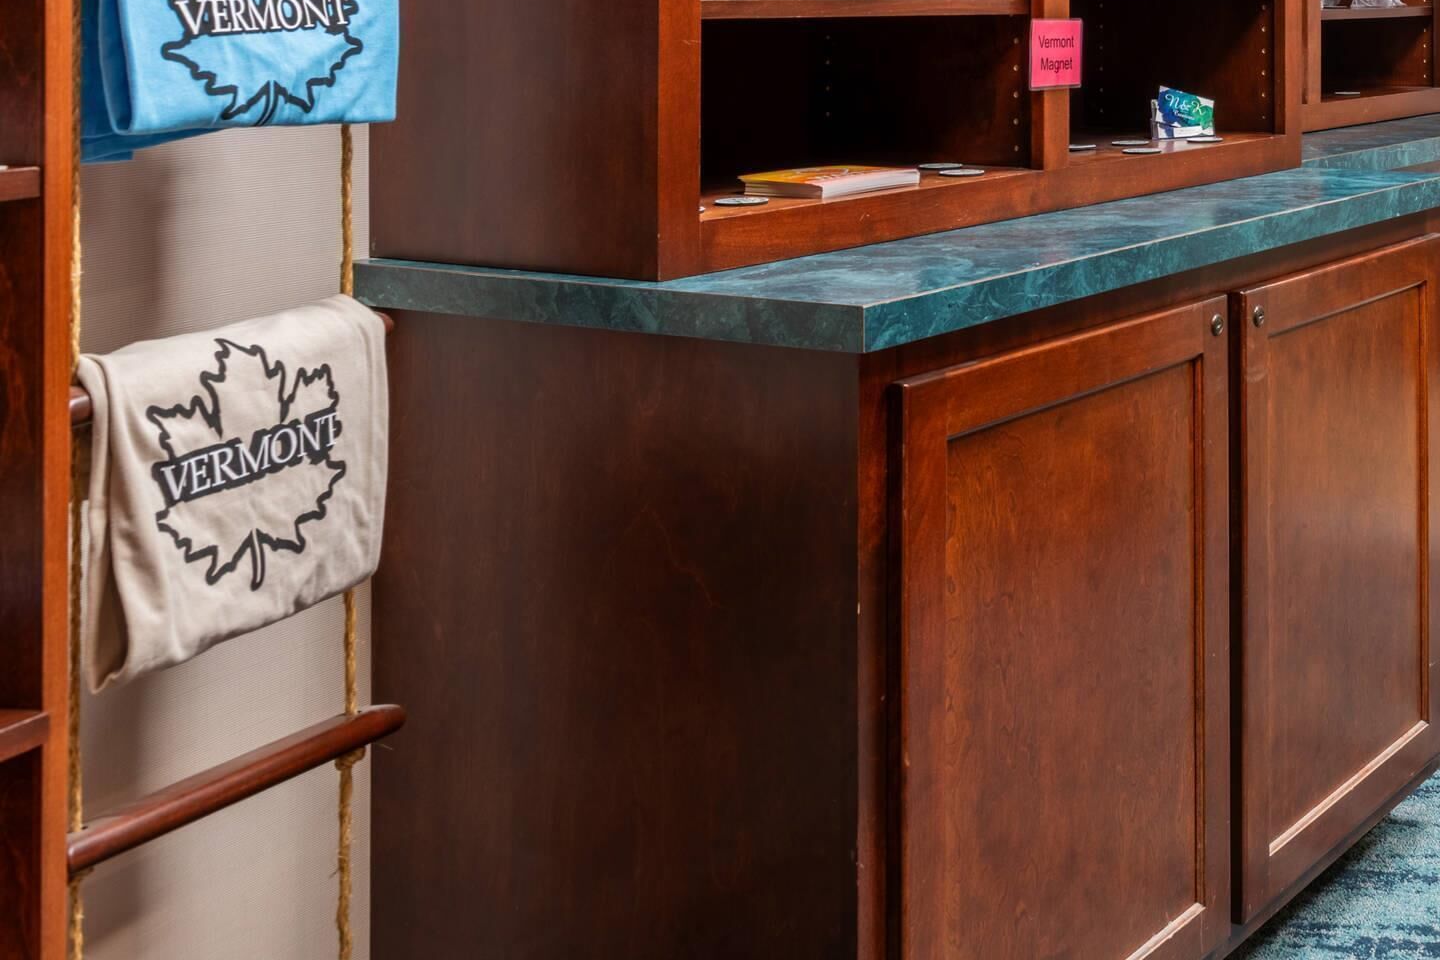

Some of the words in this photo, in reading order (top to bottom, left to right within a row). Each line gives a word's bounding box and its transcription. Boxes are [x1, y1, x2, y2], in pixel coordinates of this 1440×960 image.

[1038, 35, 1075, 49] Vermont
[1040, 57, 1073, 74] Magnet
[160, 412, 338, 501] VERMONT
